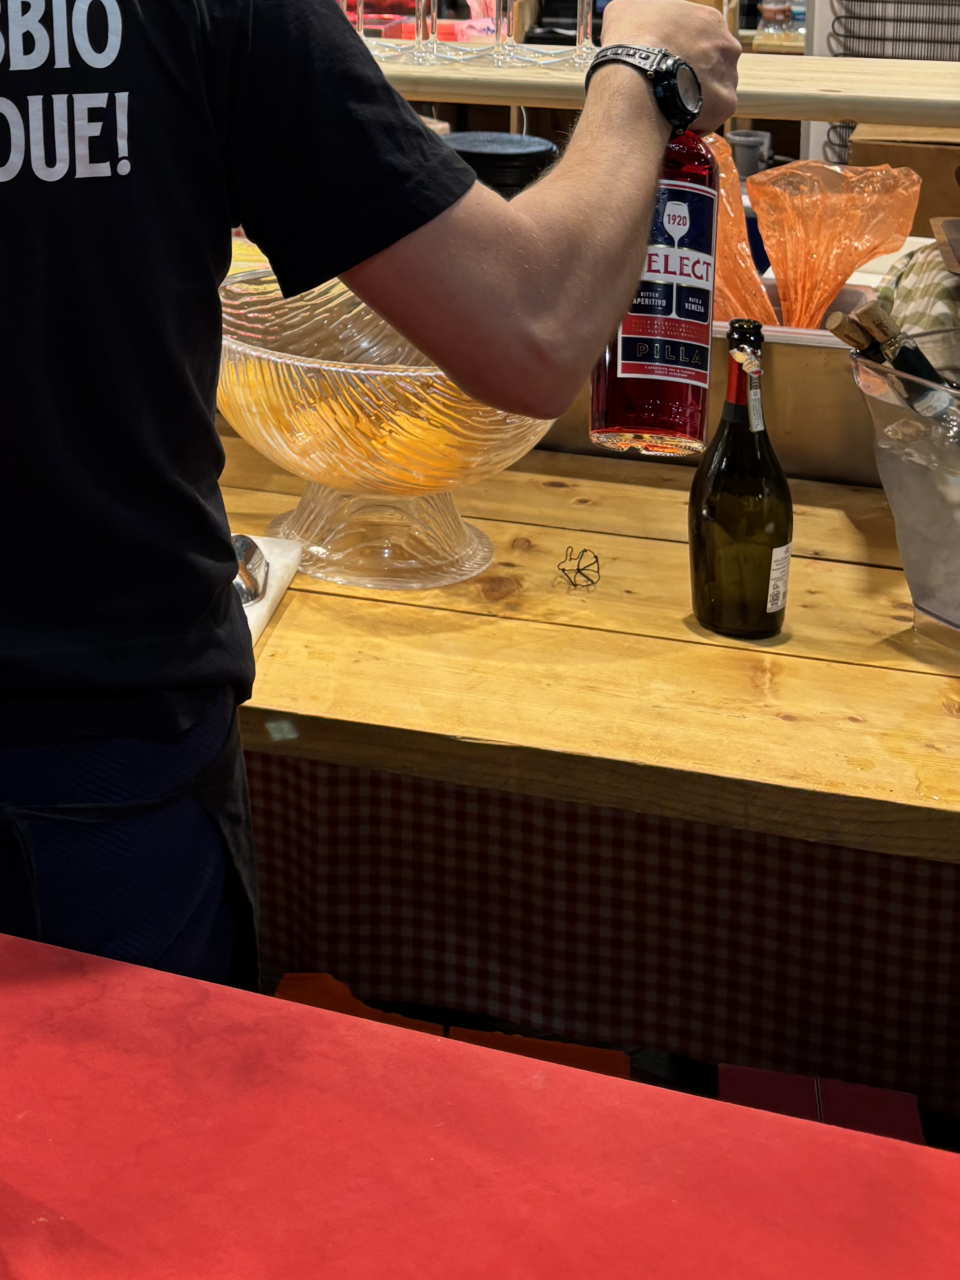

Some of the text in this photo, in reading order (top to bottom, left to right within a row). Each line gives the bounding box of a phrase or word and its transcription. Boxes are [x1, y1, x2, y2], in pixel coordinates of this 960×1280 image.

[666, 212, 688, 227] 1920
[645, 252, 712, 283] ELECT
[632, 297, 667, 307] APERITIVO
[684, 302, 705, 313] VENEZIA
[636, 342, 702, 365] PILLA
